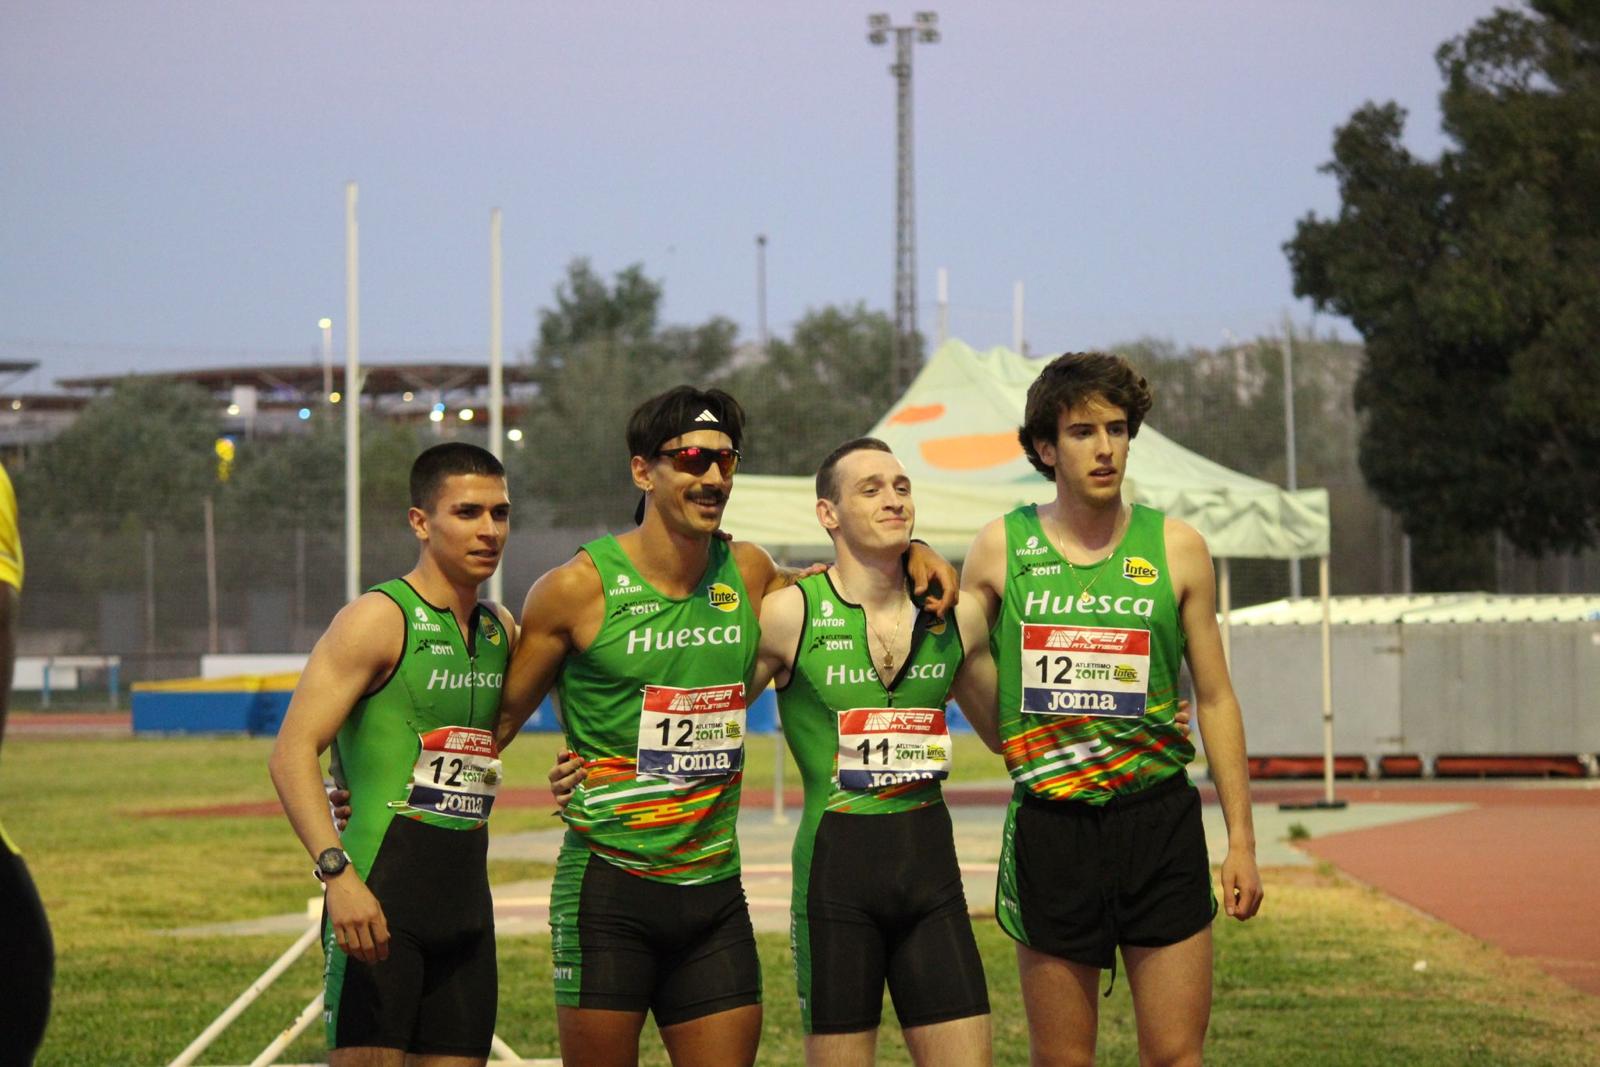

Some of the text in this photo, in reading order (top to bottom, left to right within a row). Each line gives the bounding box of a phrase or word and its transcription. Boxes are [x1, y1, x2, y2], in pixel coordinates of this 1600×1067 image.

[1016, 546, 1048, 556] VIATOR
[1032, 566, 1061, 577] ZOITI
[610, 585, 642, 596] VIATOR
[630, 602, 660, 615] ZOITI
[1024, 590, 1155, 617] Huesca
[412, 622, 441, 633] VIATOR
[812, 618, 845, 627] VIATOR
[626, 624, 741, 654] Huesca
[826, 639, 853, 651] ZOITI
[1035, 655, 1073, 684] 12
[1075, 669, 1110, 680] ZOITI
[656, 717, 693, 747] 12
[696, 729, 724, 740] ZOITI
[857, 738, 889, 765] 11
[896, 749, 925, 760] ZOITI
[430, 756, 463, 787] 12
